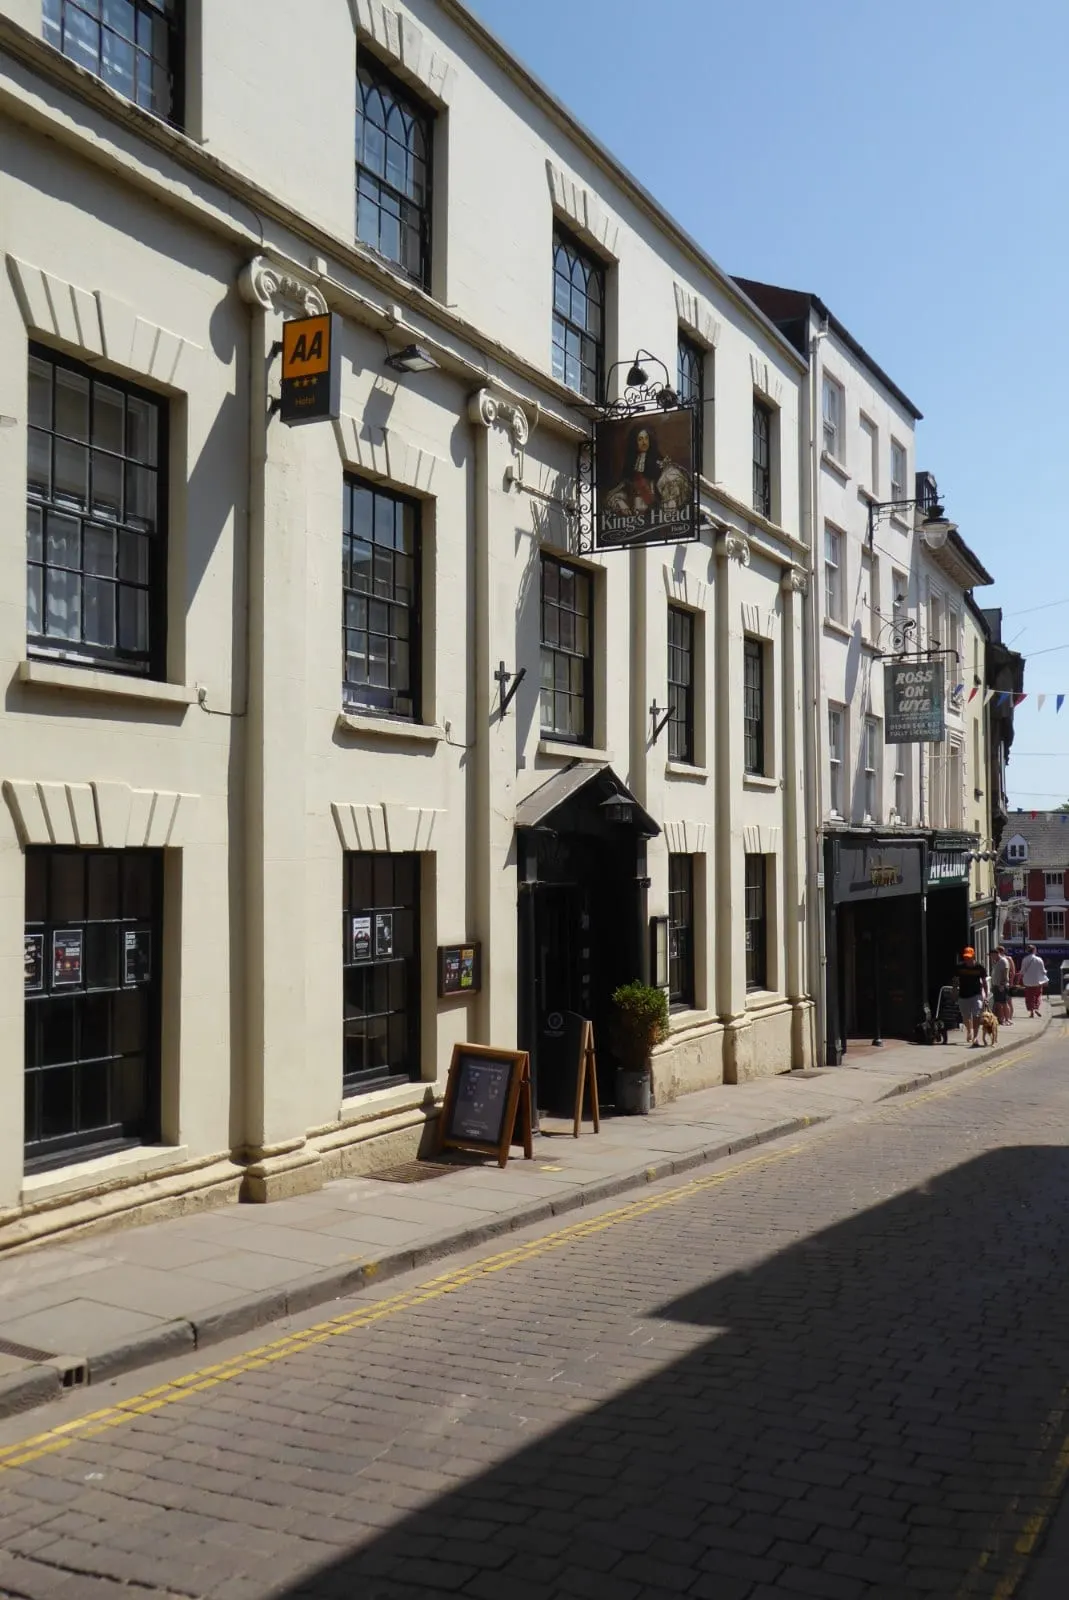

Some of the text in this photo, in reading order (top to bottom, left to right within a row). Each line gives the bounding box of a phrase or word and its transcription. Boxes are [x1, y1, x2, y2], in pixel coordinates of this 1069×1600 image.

[289, 331, 322, 364] AA
[601, 505, 690, 532] King's Head
[895, 671, 933, 685] ROSS
[899, 699, 931, 712] WYE
[930, 853, 966, 879] AVELLINO
